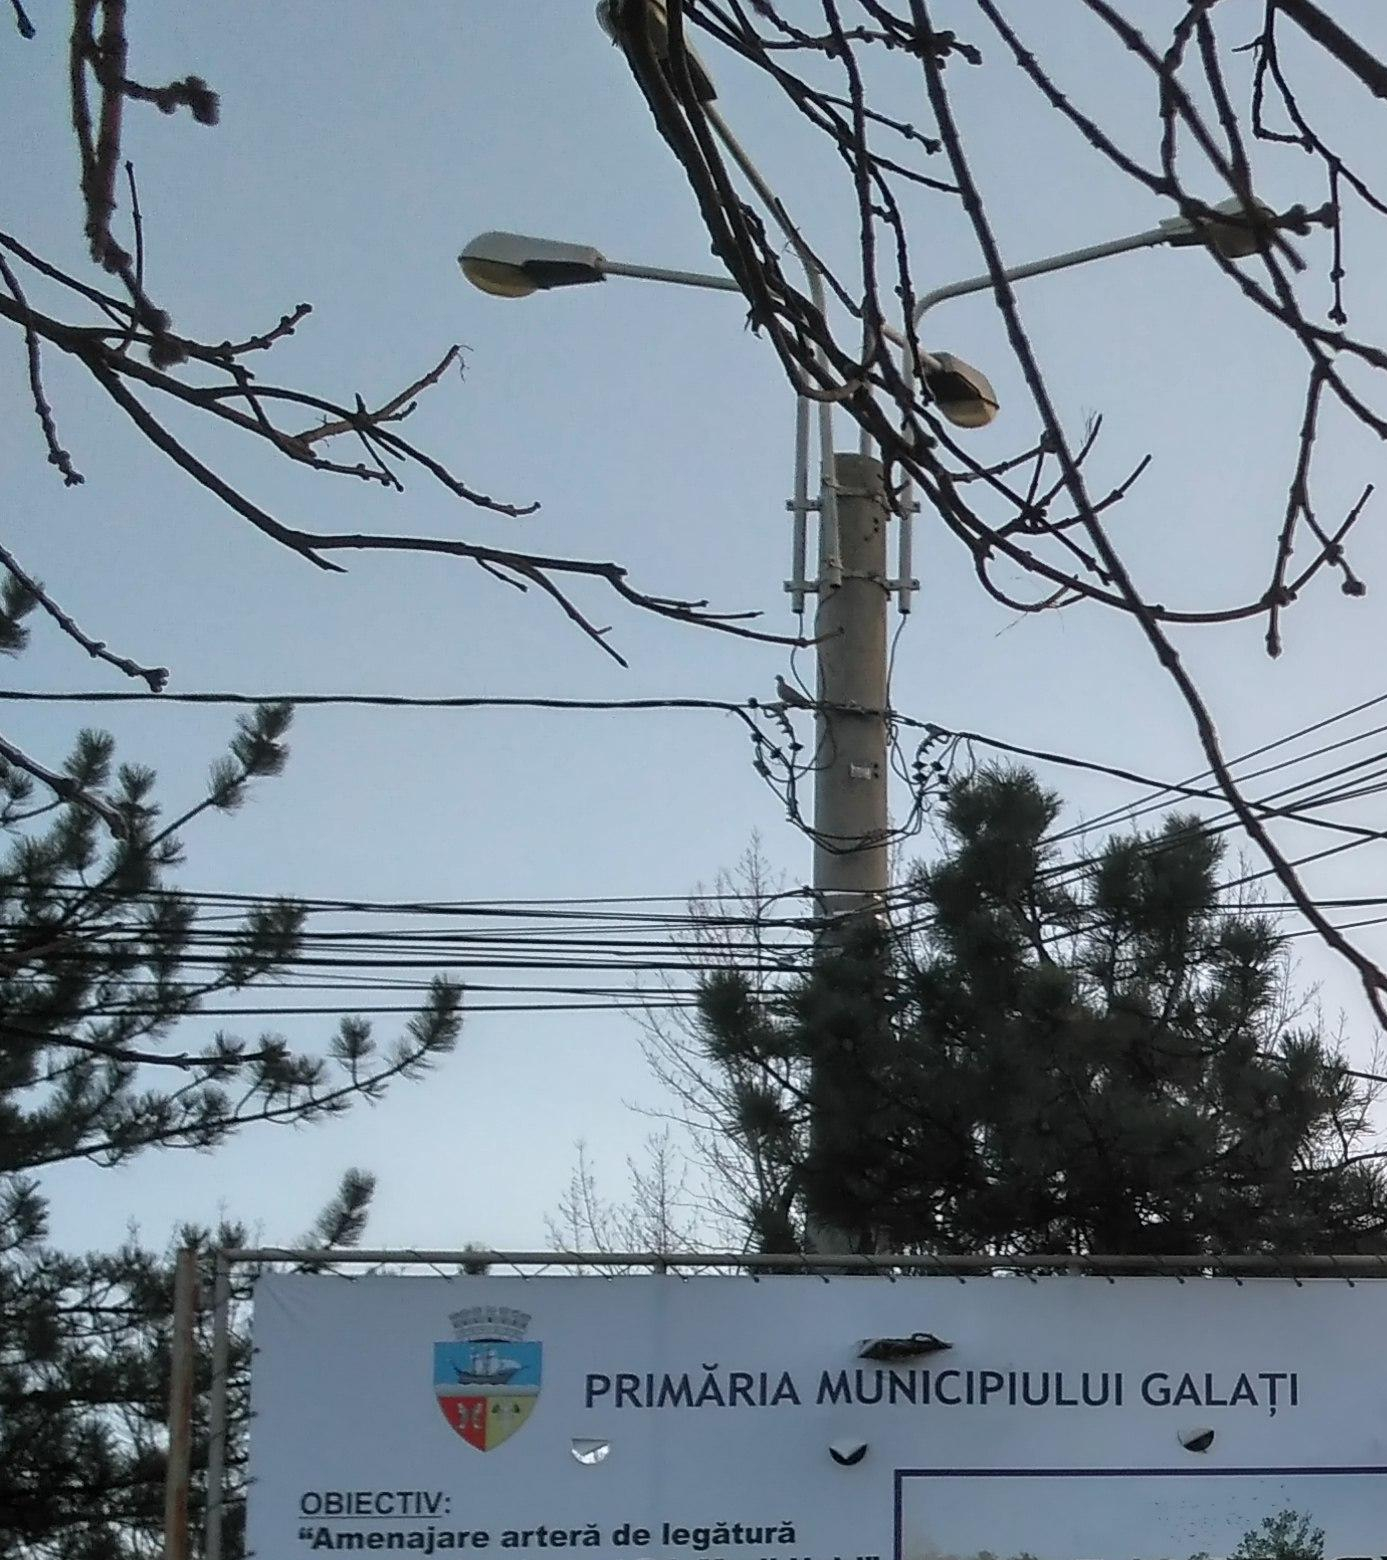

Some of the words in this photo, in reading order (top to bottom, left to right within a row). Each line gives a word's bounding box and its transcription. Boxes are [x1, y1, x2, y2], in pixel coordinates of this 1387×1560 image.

[585, 1362, 802, 1409] PRIMĂRIA
[815, 1366, 1123, 1407] MUNICIPIULUI
[1141, 1372, 1298, 1418] GALAȚI
[300, 1491, 451, 1515] OBIECTIV:
[500, 1523, 601, 1549] arteră
[612, 1523, 652, 1547] de
[662, 1520, 796, 1552] legătură
